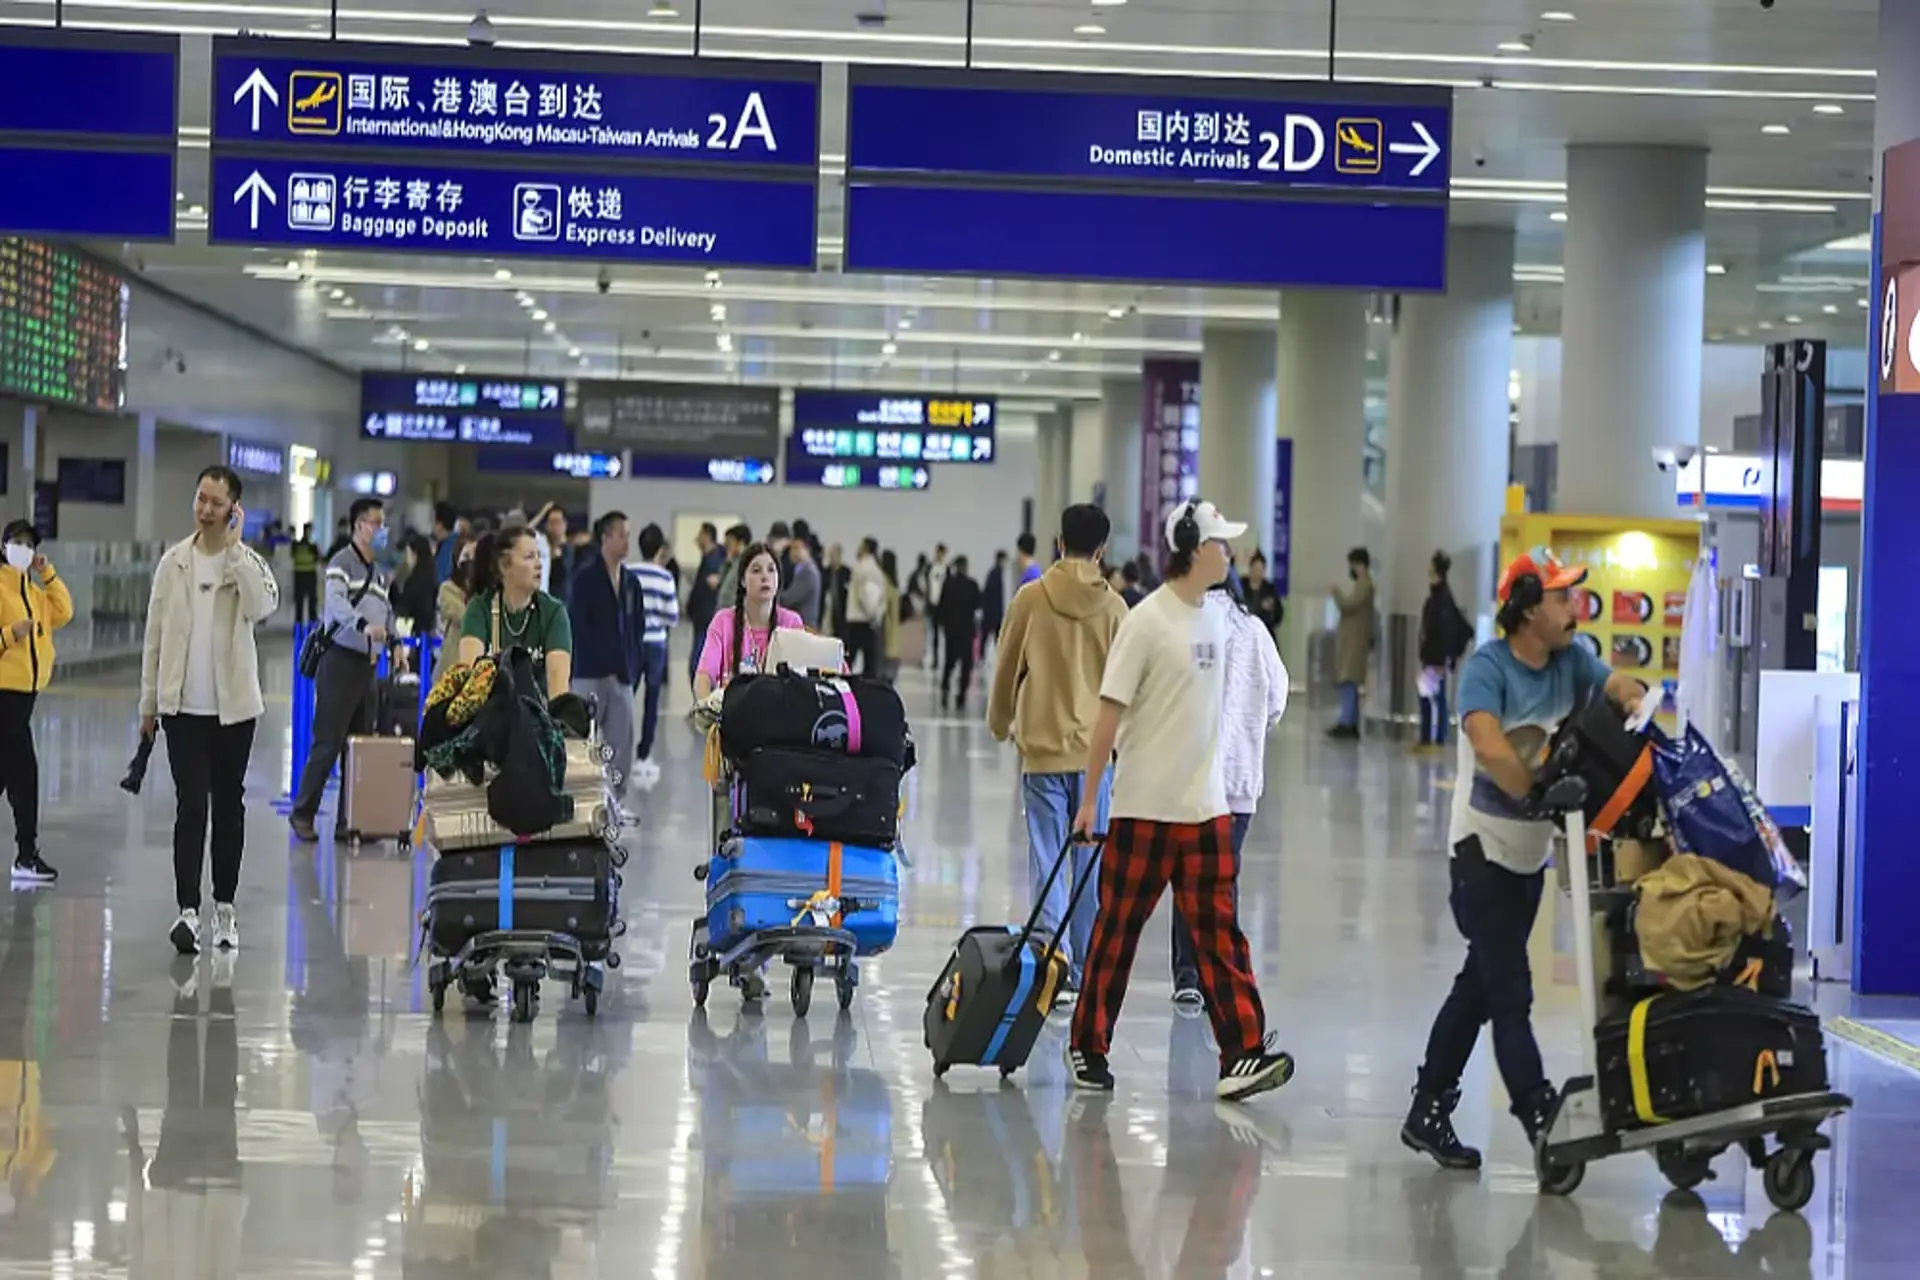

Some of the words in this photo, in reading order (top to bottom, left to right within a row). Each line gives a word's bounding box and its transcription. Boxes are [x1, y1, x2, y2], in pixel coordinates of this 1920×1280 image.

[347, 73, 603, 121] 国际、港澳台到达
[645, 126, 700, 149] Arrivals
[706, 91, 778, 151] 2A
[1137, 109, 1251, 145] 国内到达
[1089, 144, 1175, 166] Domestic
[1179, 147, 1251, 170] Arrivals
[1257, 113, 1325, 172] 2D
[342, 175, 464, 213] 行李寄存
[567, 185, 623, 221] 快递
[341, 212, 417, 239] Baggage
[422, 215, 489, 241] Deposit
[565, 222, 636, 247] Express
[640, 225, 717, 253] Delivery
